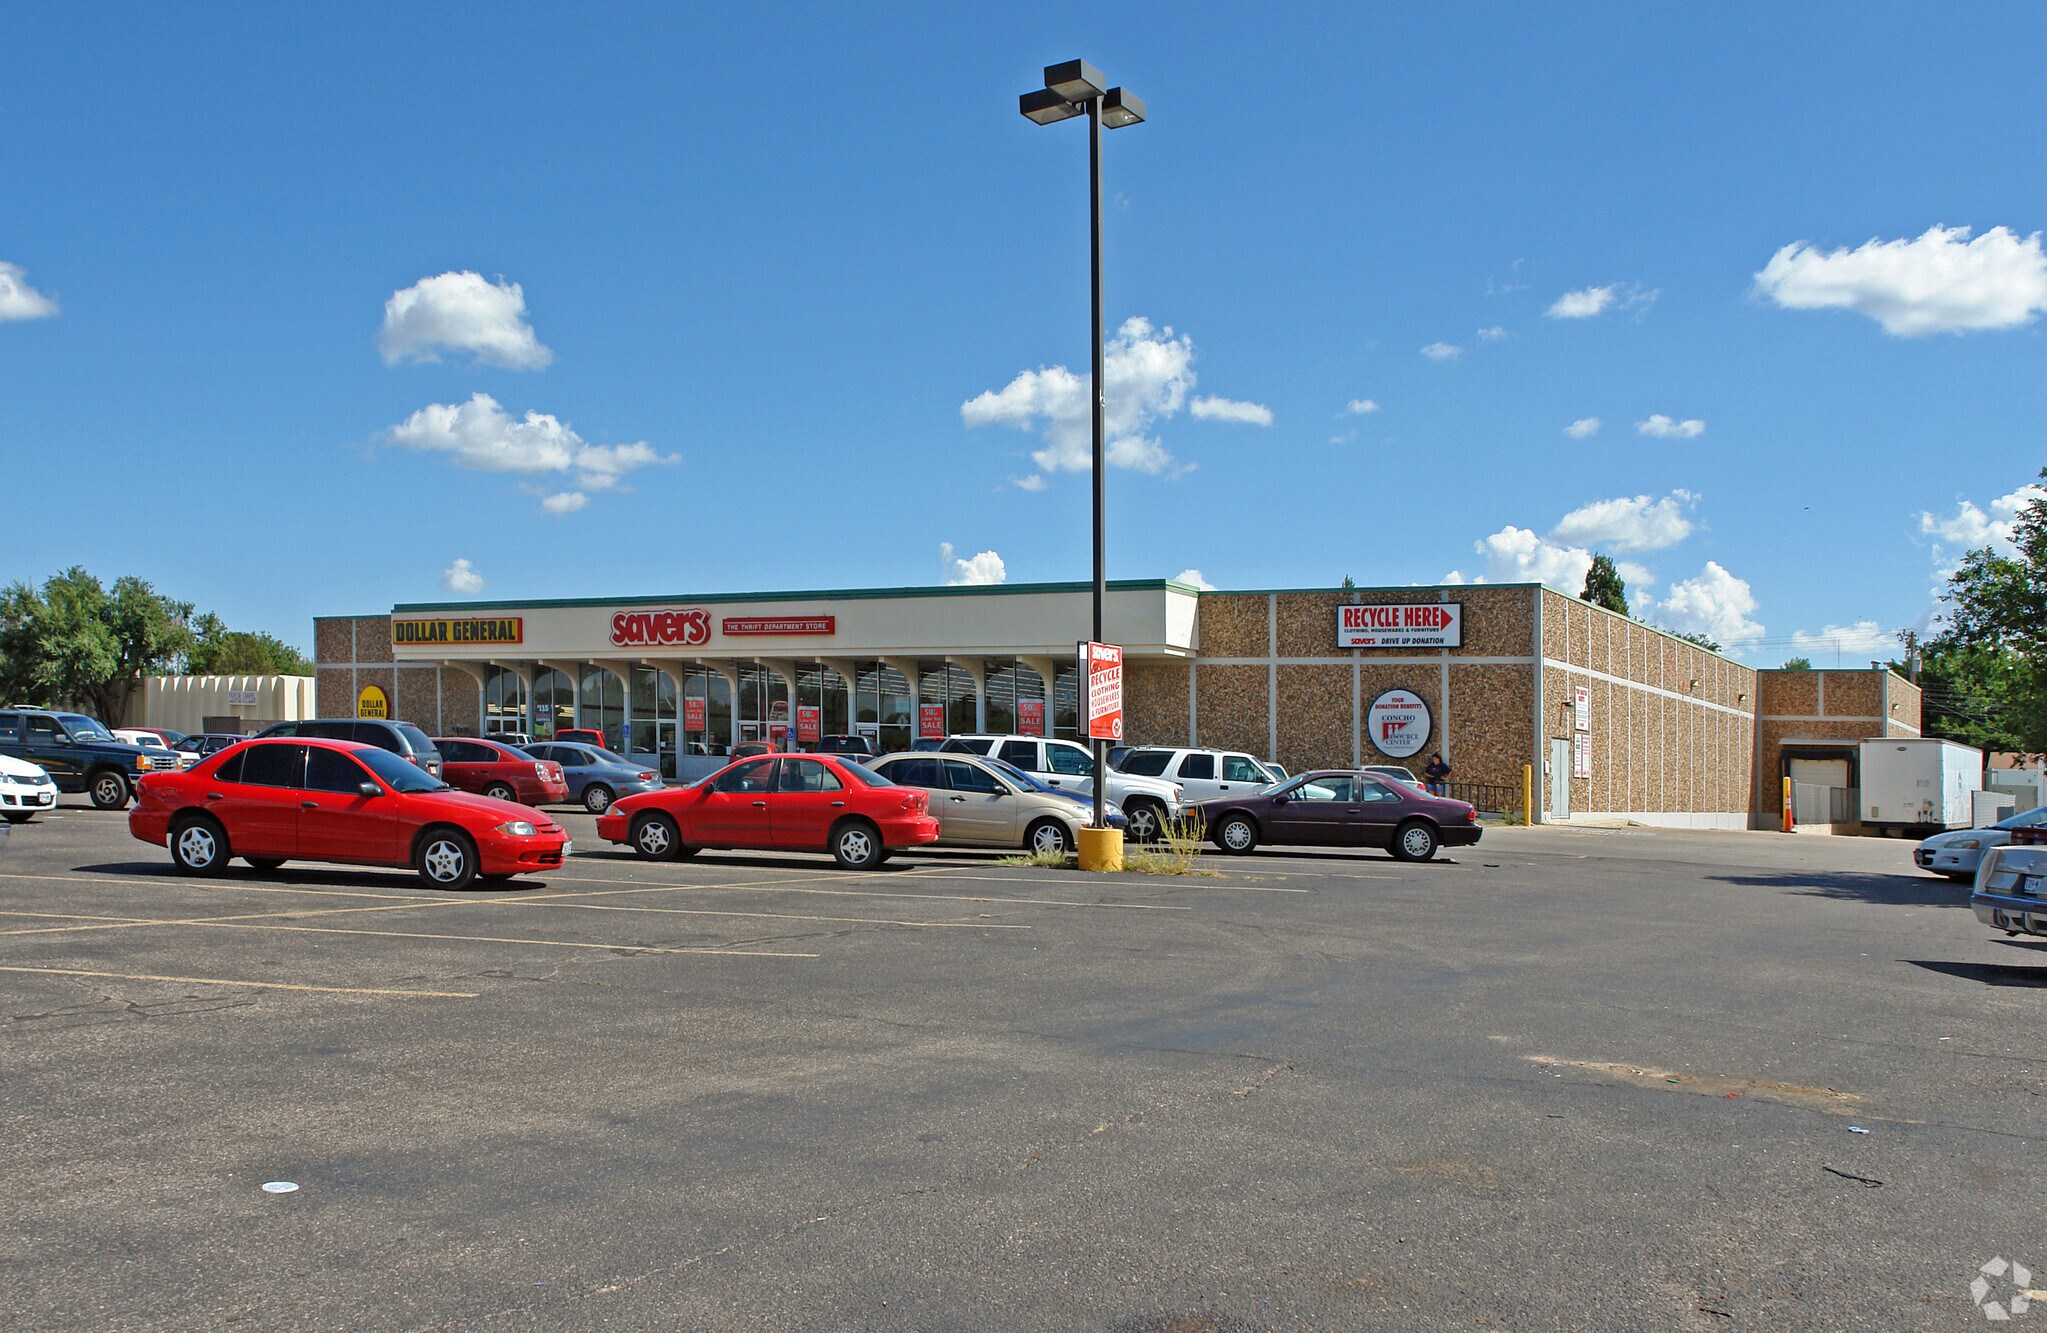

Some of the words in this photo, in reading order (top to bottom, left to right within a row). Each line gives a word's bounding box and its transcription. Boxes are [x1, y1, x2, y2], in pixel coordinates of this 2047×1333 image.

[1344, 607, 1400, 628] RECYCLE
[1404, 606, 1440, 627] HERE
[395, 621, 449, 642] DOLLAR
[452, 620, 516, 641] GENERAL
[611, 610, 709, 646] savers
[727, 623, 739, 631] THE
[741, 623, 762, 631] THRIFT
[764, 623, 804, 631] DEPARTMENT
[805, 622, 827, 630] STORE
[1350, 637, 1376, 645] savers
[1381, 637, 1400, 645] DRIVE
[1401, 637, 1411, 645] UP
[1412, 637, 1445, 645] DONATION
[1090, 667, 1120, 688] RECYCLE
[1091, 681, 1120, 698] CLOTHING
[361, 699, 384, 709] DOLLAR
[360, 708, 386, 718] GENERAL
[922, 721, 942, 729] SALE
[1020, 717, 1041, 725] SALE
